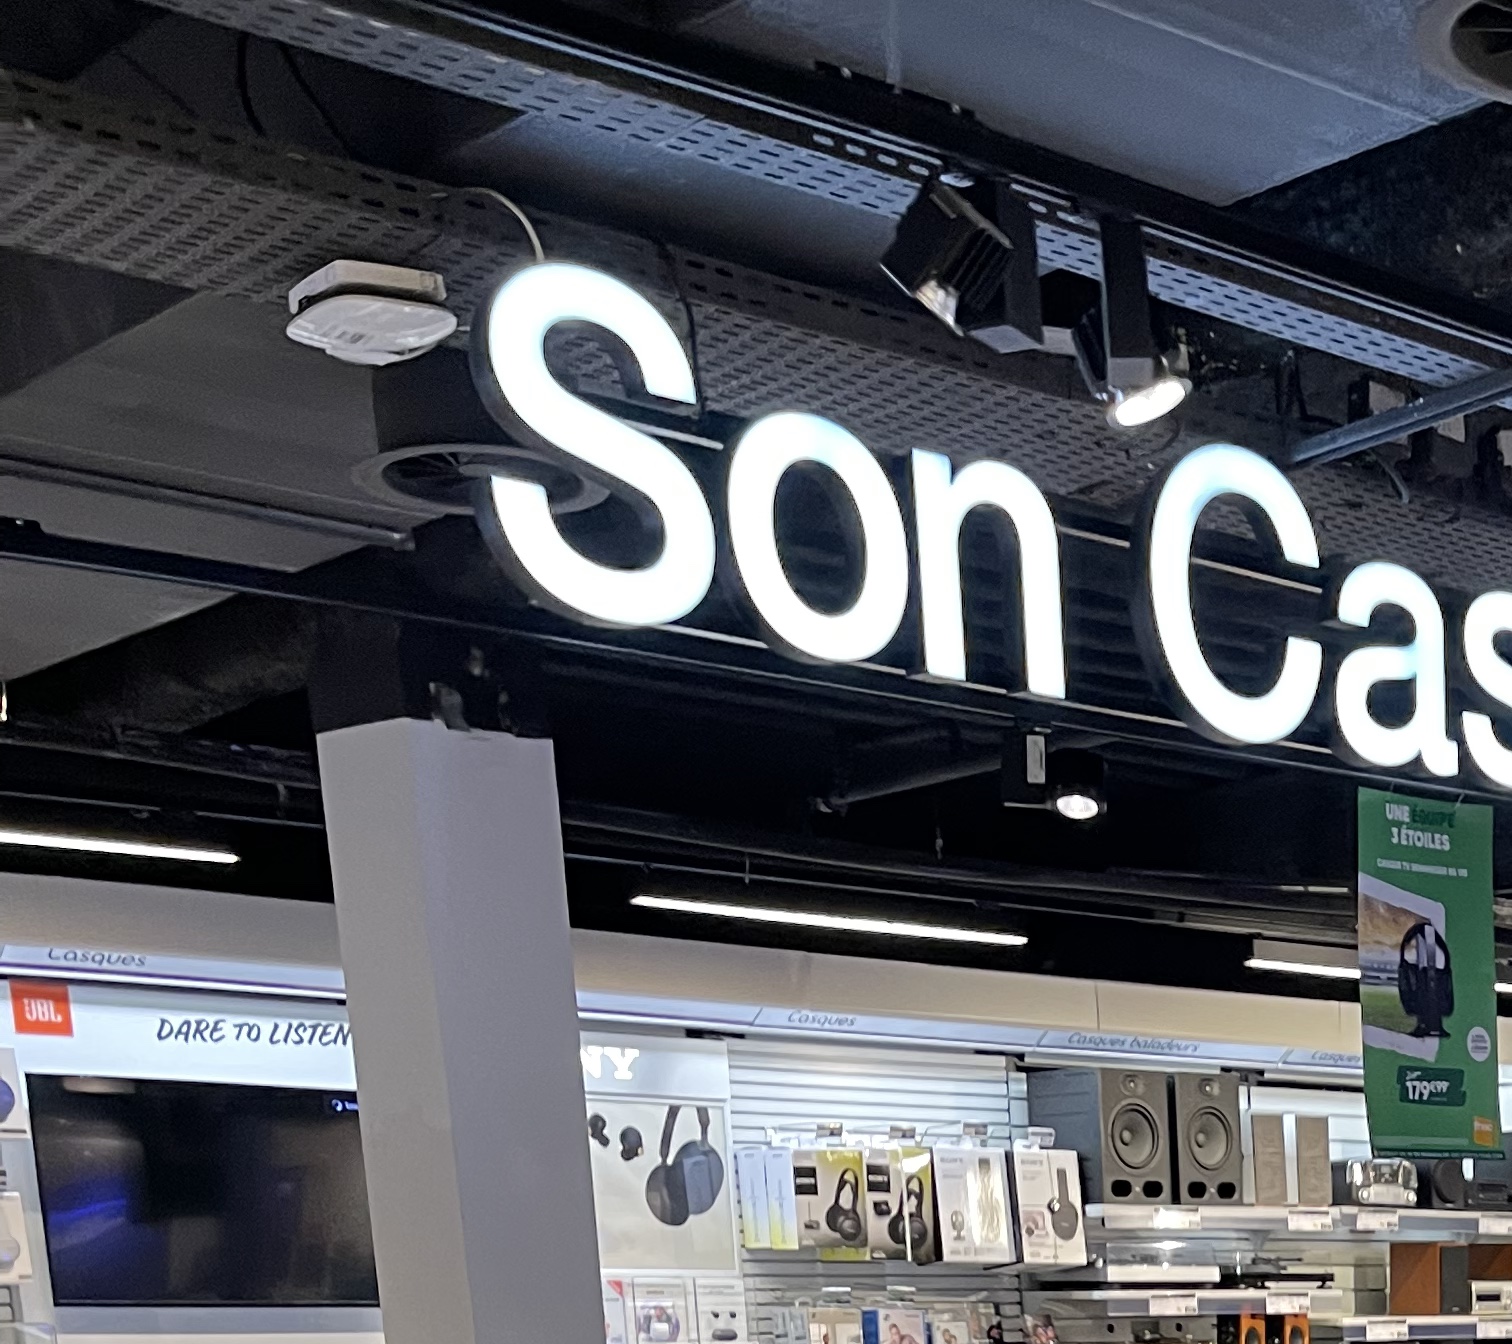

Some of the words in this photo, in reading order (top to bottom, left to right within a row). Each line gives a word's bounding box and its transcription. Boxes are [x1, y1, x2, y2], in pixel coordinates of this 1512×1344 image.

[488, 262, 1066, 699] Son
[1385, 802, 1411, 823] UNE
[1390, 826, 1400, 844] 3
[1400, 824, 1452, 852] ÉTOILES
[23, 998, 63, 1024] JBL
[786, 1009, 858, 1030] Casques
[156, 1017, 227, 1044] DARE
[232, 1022, 262, 1043] TO
[268, 1021, 351, 1048] LISTEN
[1067, 1031, 1126, 1049] Casques
[580, 1044, 640, 1080] NY
